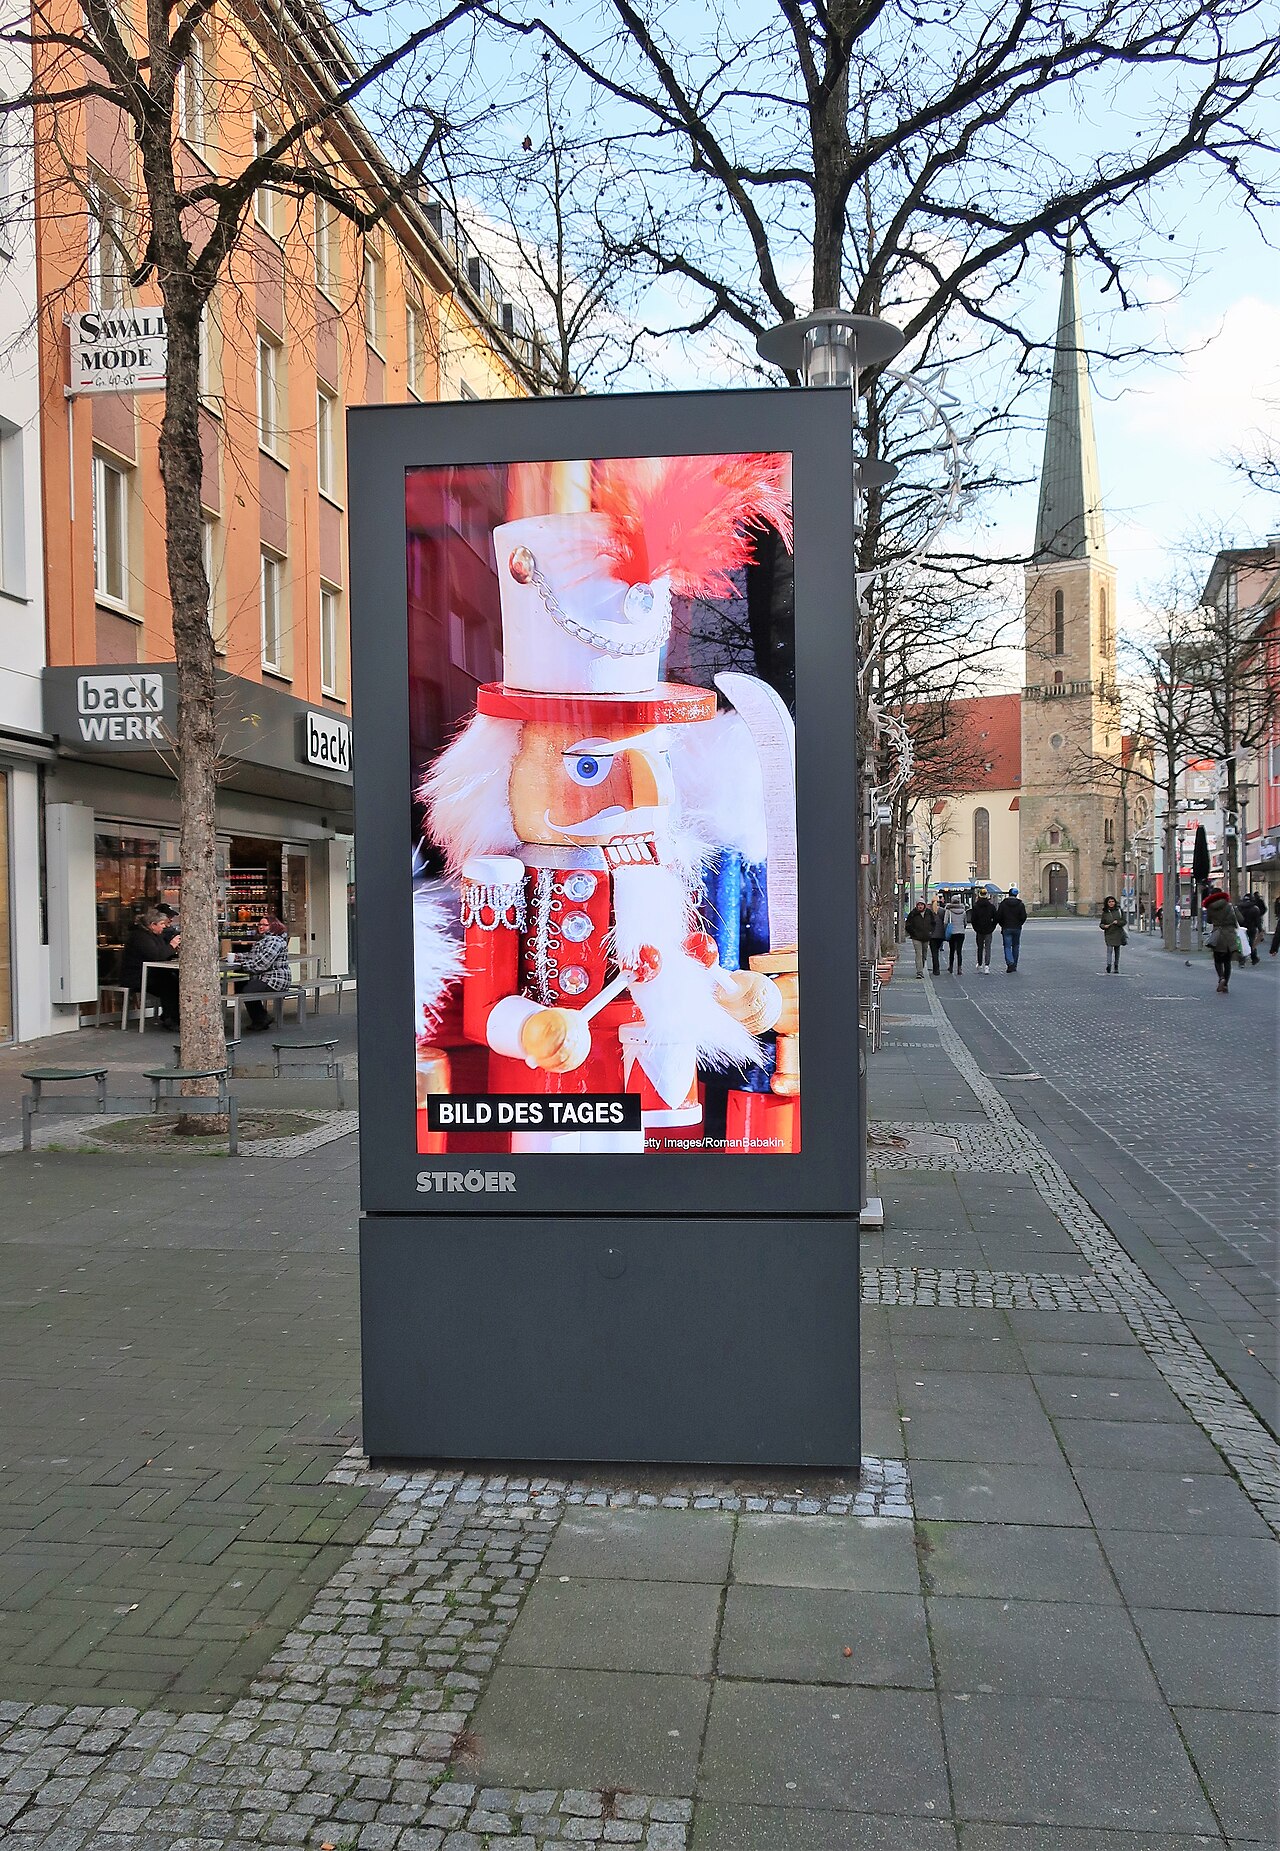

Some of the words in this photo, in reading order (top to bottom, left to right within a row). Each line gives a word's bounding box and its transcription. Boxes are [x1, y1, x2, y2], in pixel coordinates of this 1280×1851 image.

[80, 348, 152, 371] MODE
[108, 374, 135, 386] 40-60
[82, 678, 158, 710] back
[78, 716, 164, 741] WERK
[310, 717, 347, 766] back
[438, 1102, 492, 1124] BILD
[498, 1102, 544, 1124] DES
[550, 1101, 625, 1124] TAGES
[415, 1169, 518, 1193] STRÖER
